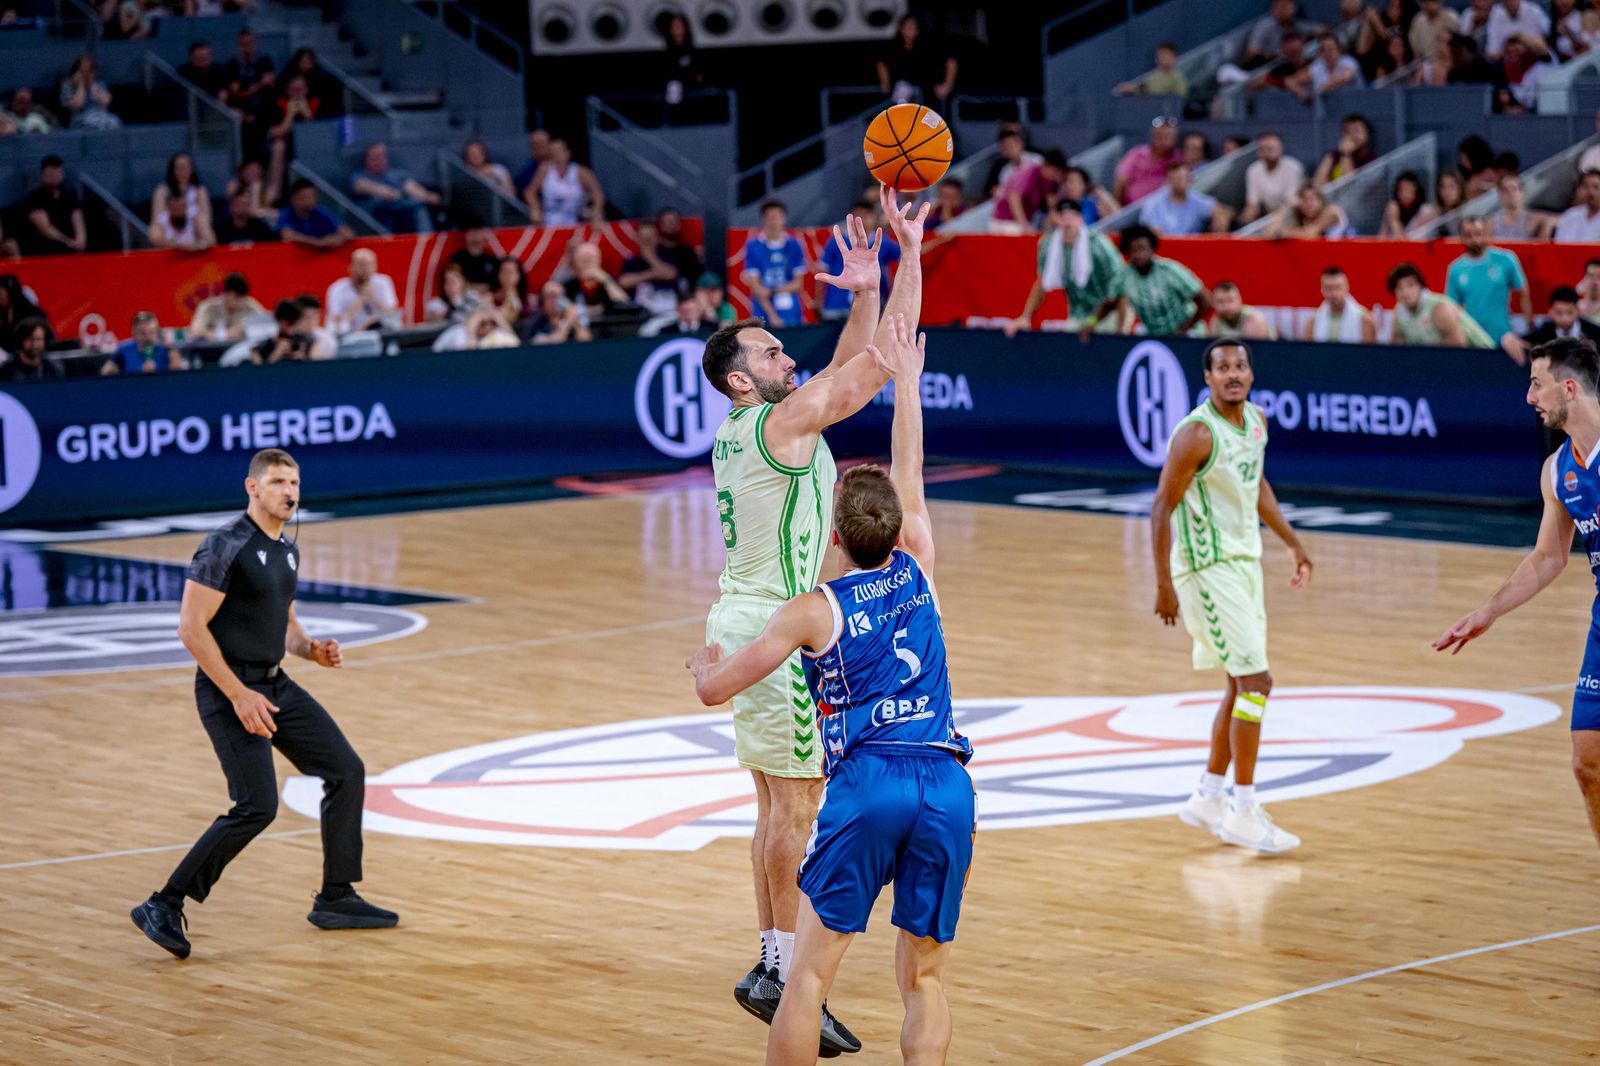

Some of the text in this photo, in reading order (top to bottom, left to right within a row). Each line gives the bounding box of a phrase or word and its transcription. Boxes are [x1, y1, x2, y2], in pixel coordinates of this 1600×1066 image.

[56, 402, 397, 464] GRUPO HEREDA
[1307, 391, 1438, 438] HEREDA
[892, 627, 922, 685] 5
